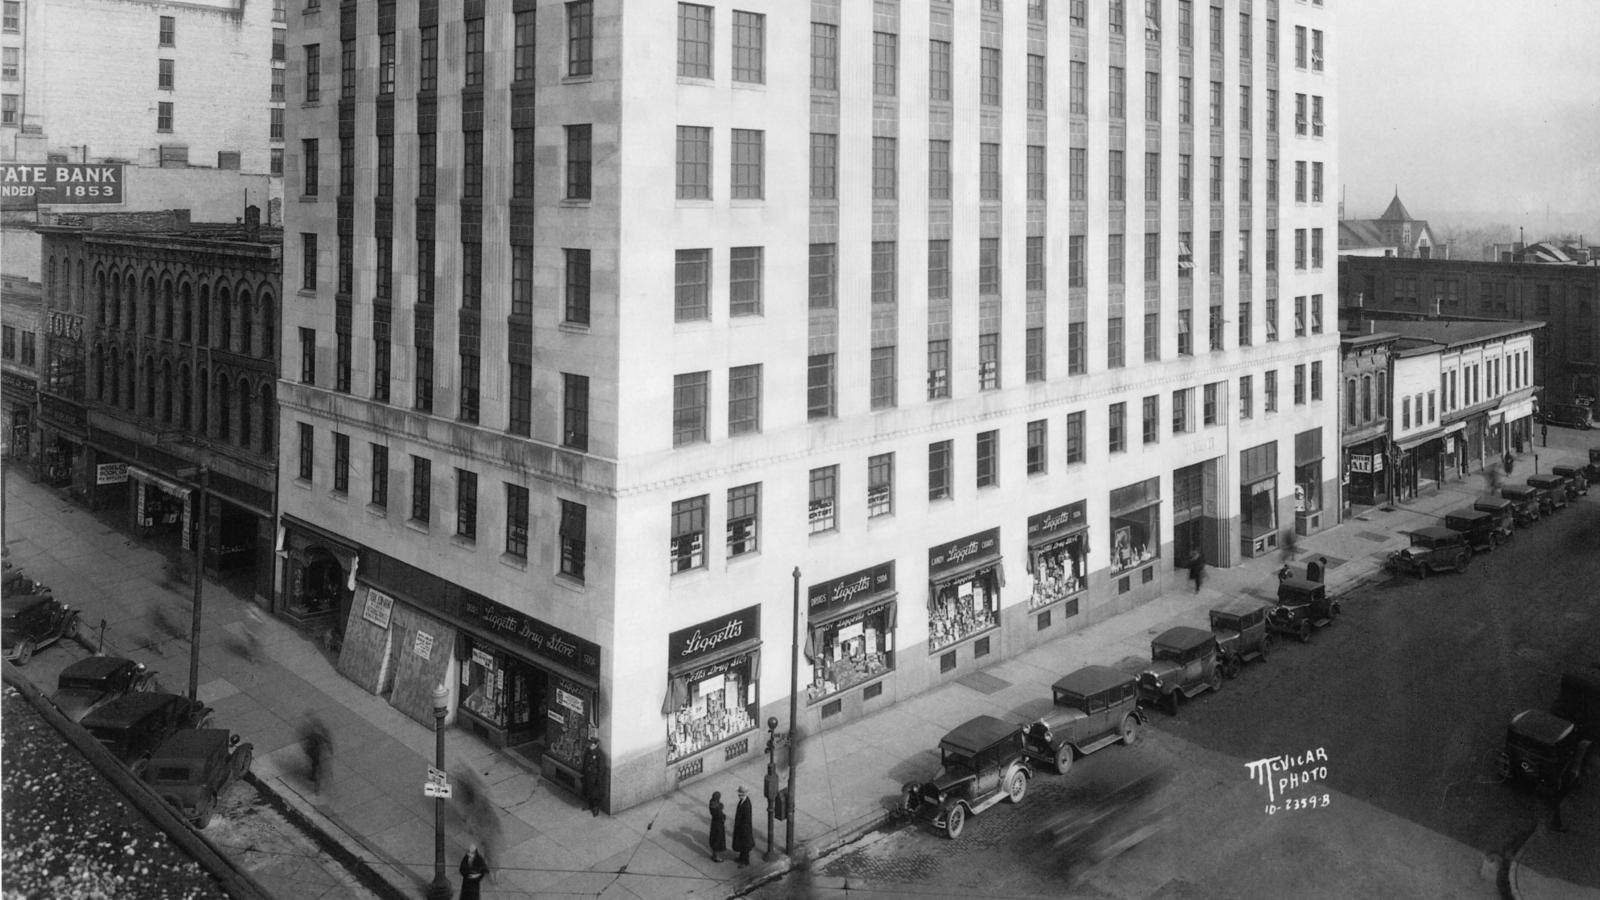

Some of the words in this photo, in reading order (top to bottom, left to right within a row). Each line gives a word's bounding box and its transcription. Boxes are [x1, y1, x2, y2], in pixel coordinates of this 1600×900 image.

[56, 167, 116, 182] BANK
[66, 186, 114, 196] 1853
[48, 312, 81, 341] TOYS
[519, 619, 544, 648] Drug
[546, 633, 576, 657] Store
